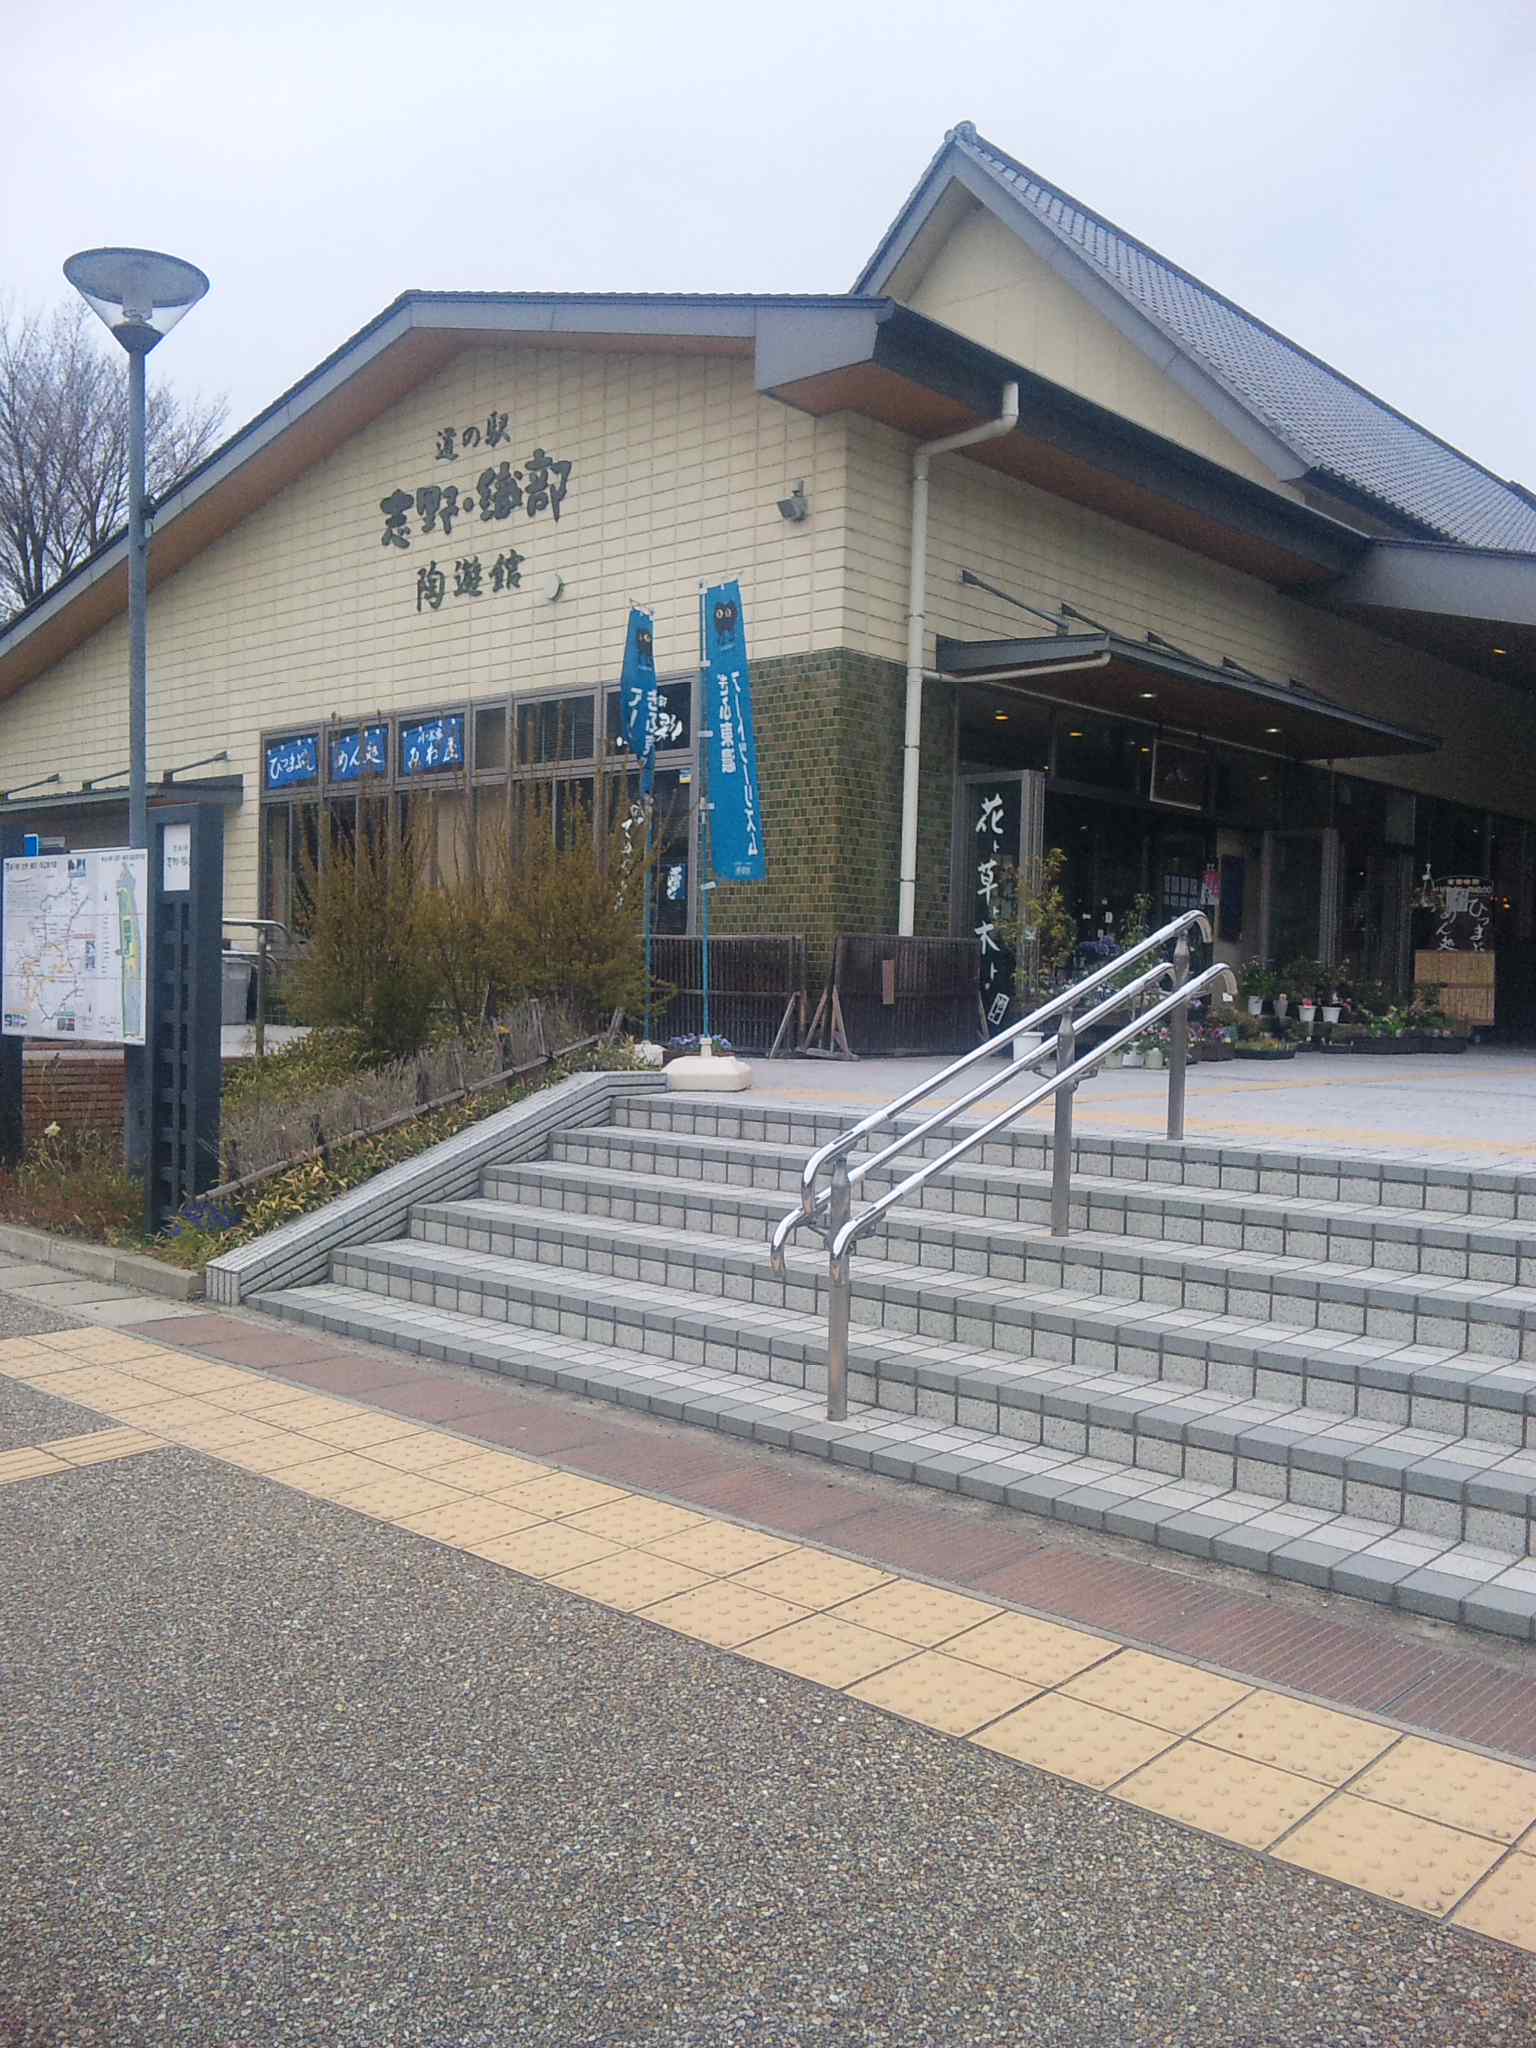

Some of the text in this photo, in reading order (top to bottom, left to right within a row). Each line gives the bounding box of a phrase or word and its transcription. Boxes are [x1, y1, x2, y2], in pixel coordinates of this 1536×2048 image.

[435, 411, 511, 461] 道の駅
[380, 448, 572, 549] 志野・織部
[416, 549, 526, 612] 陶遊館
